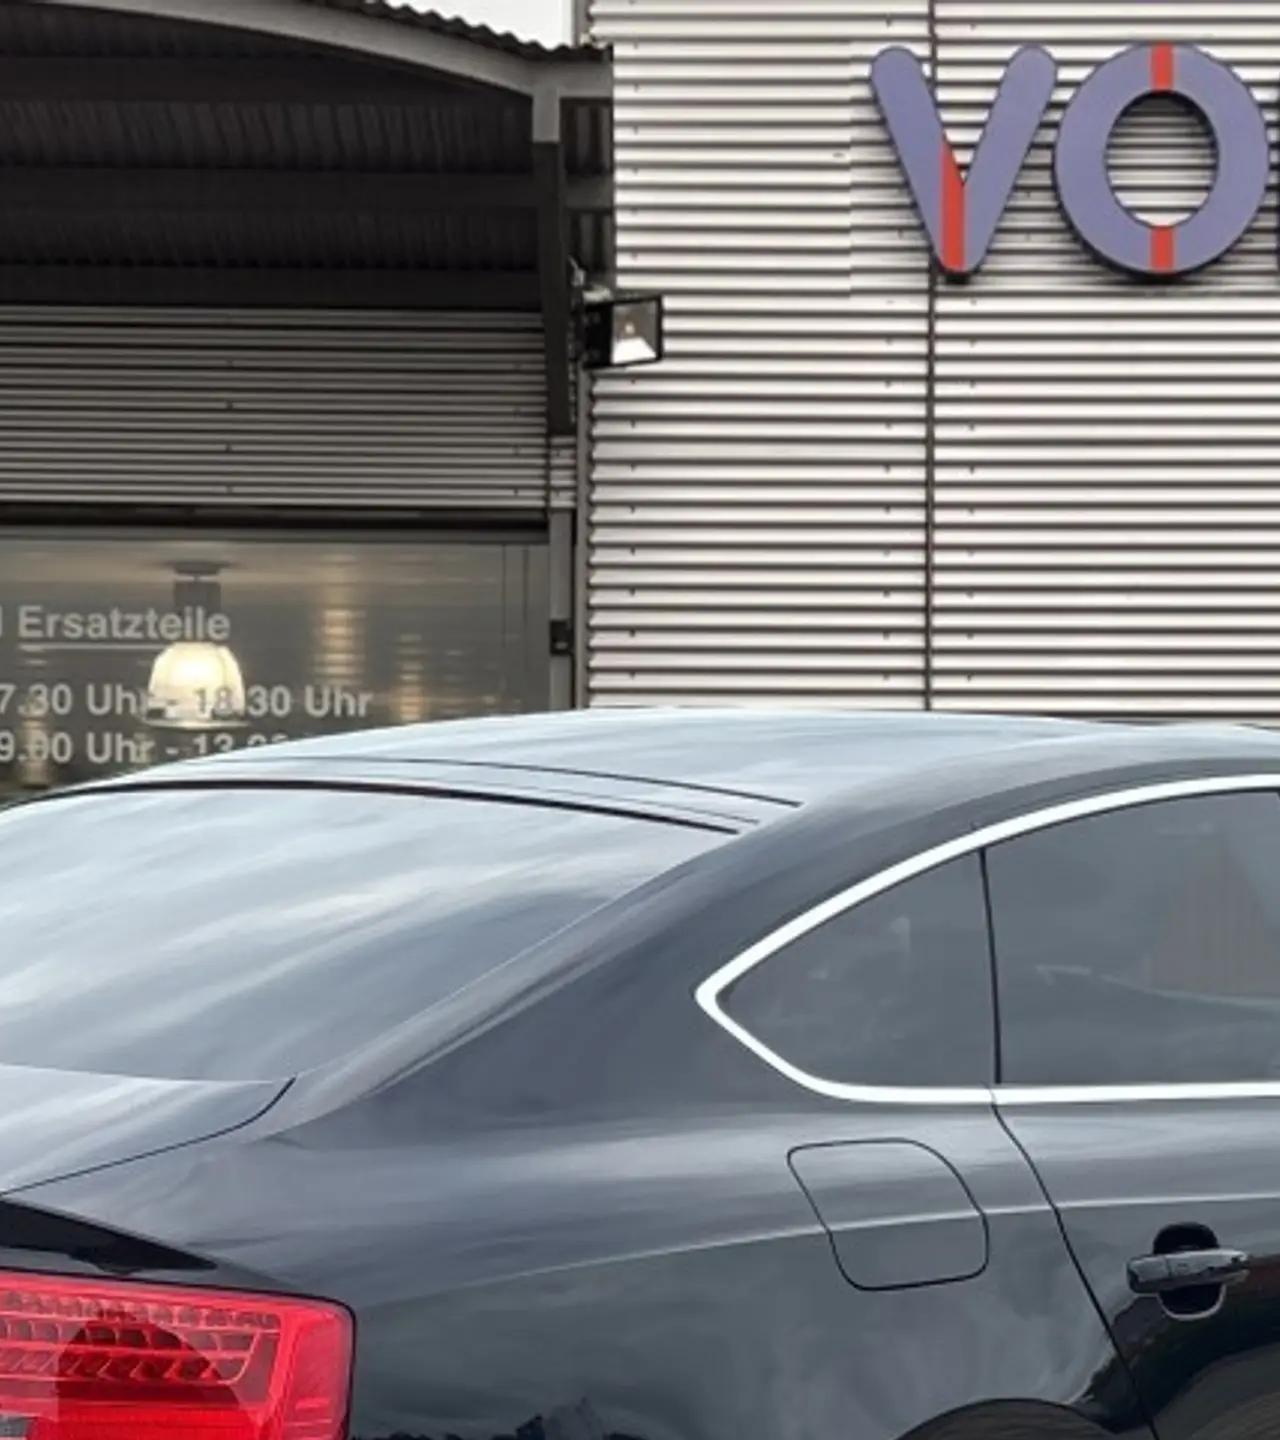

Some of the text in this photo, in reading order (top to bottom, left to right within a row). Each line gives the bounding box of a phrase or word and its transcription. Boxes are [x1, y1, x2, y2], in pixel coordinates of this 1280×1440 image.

[18, 606, 231, 641] Ersatzteile
[304, 684, 373, 718] Uhr
[86, 731, 155, 764] Uhr
